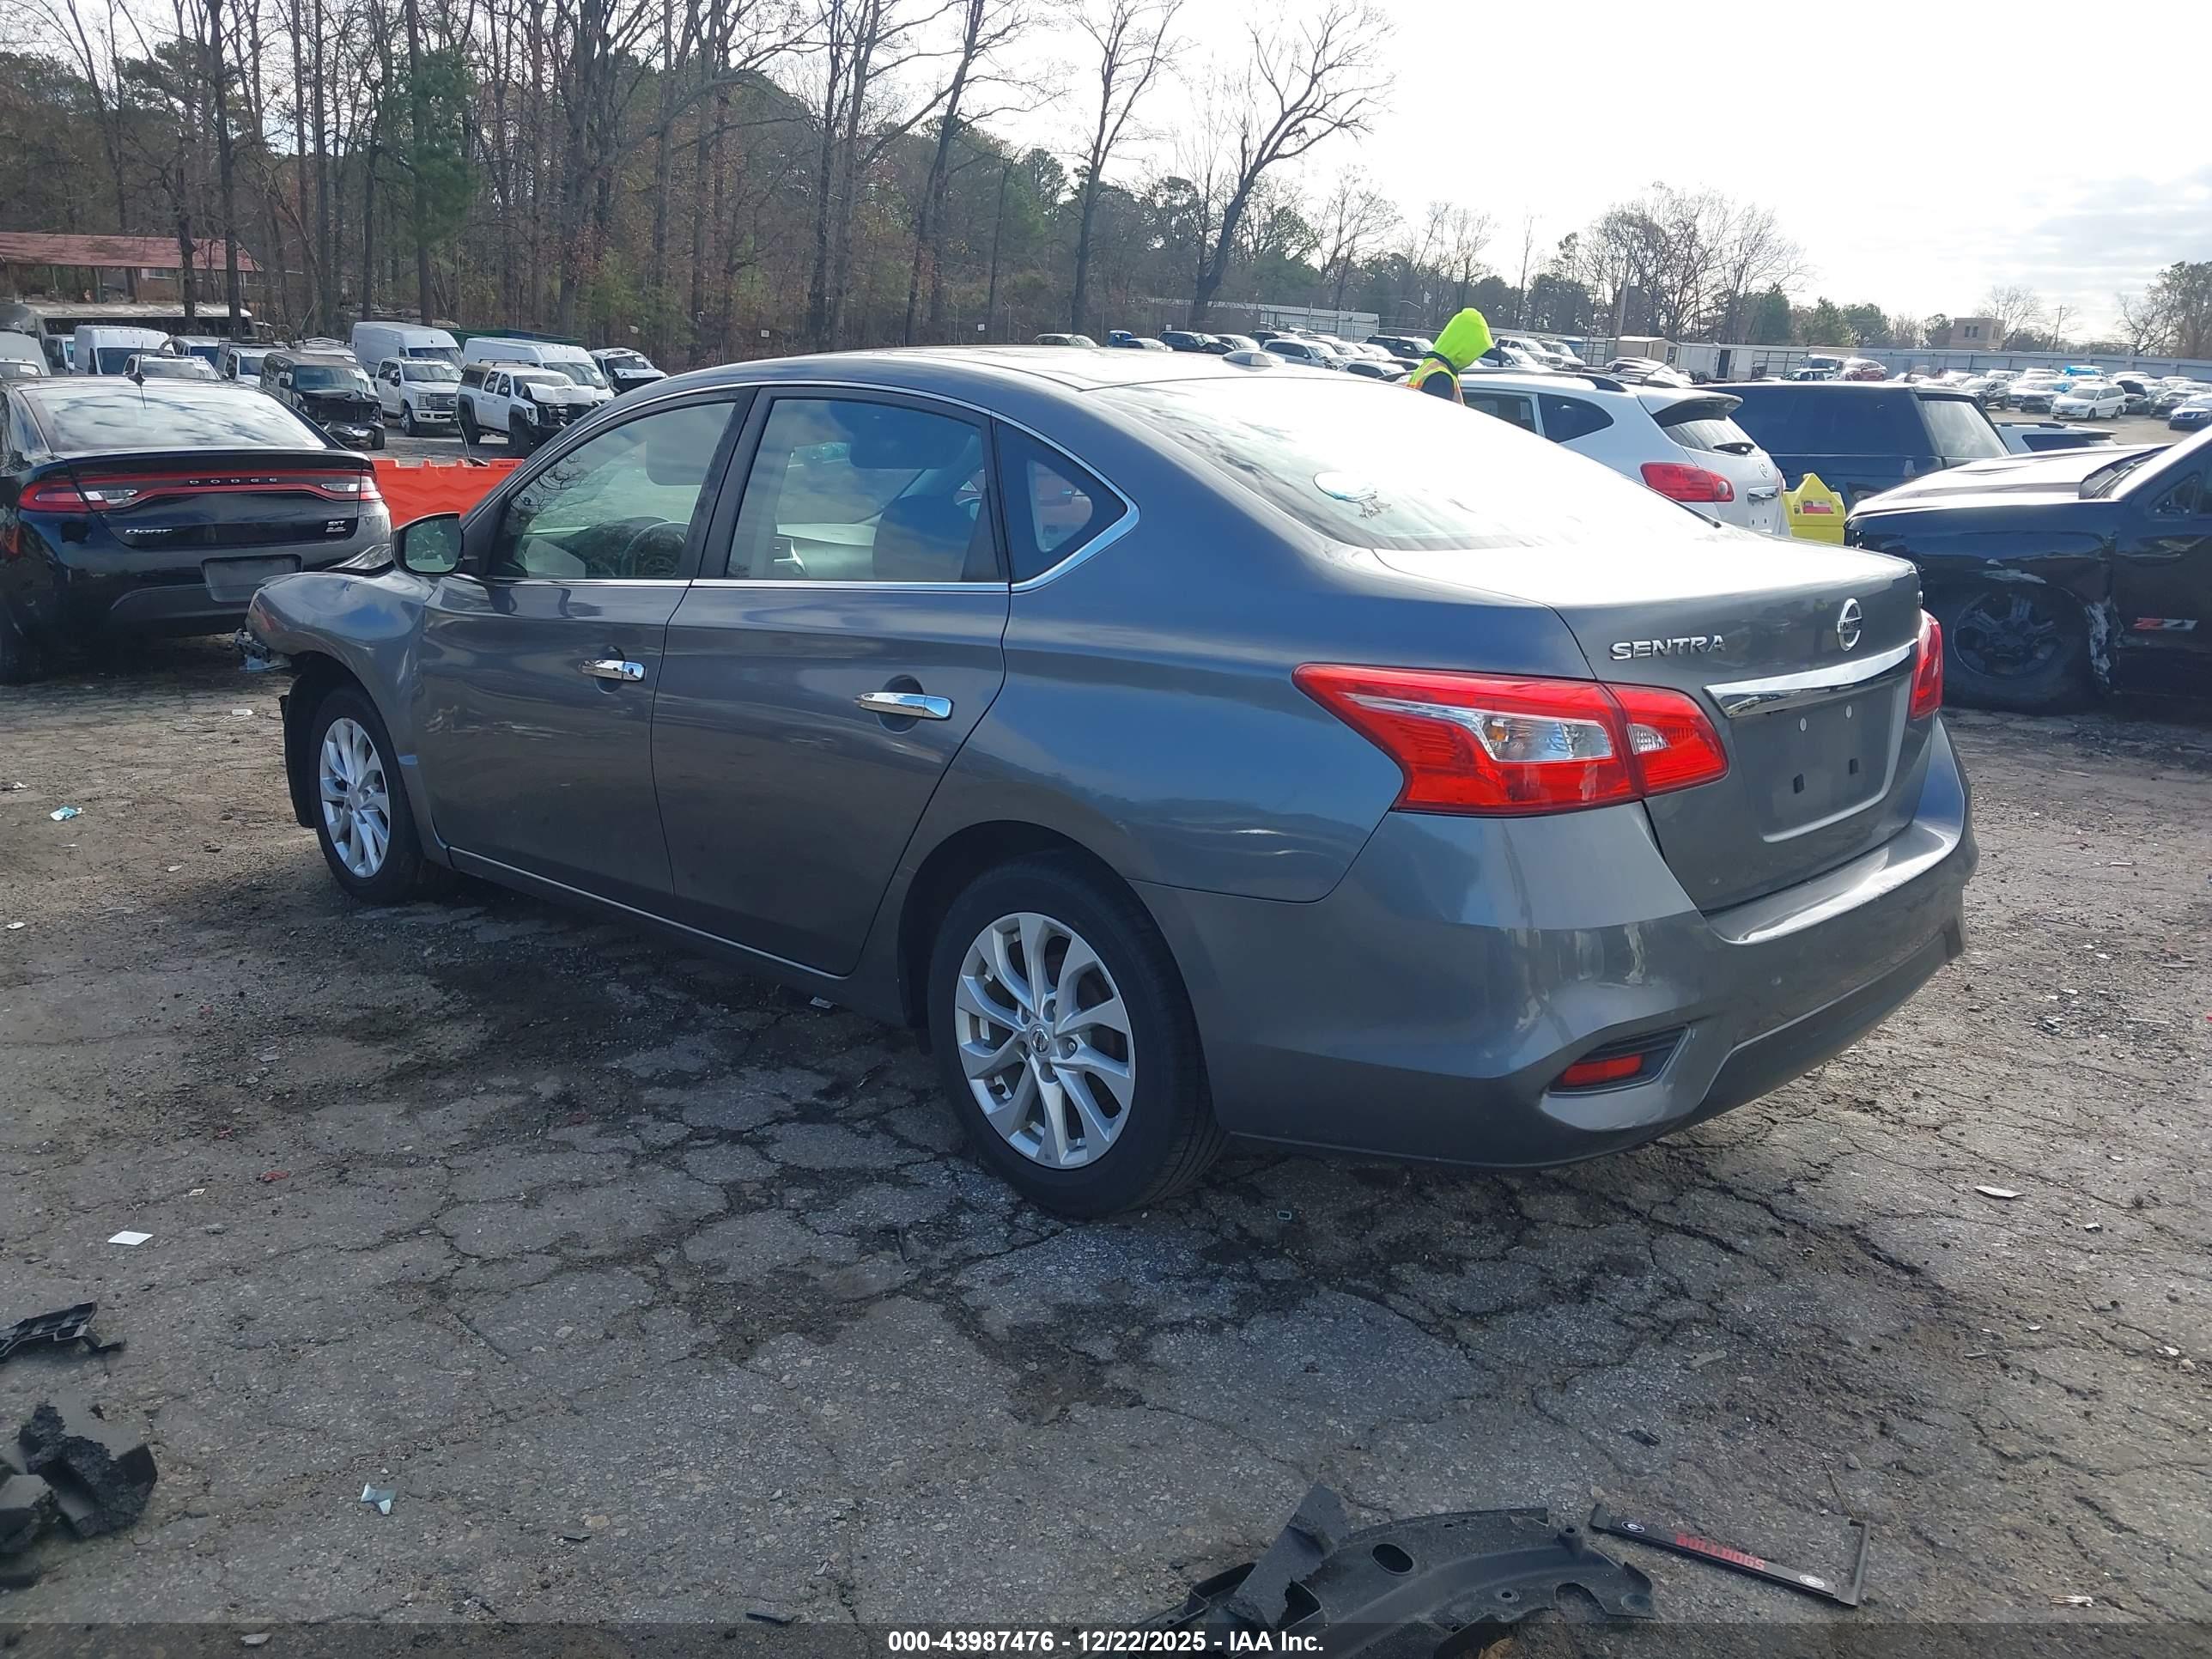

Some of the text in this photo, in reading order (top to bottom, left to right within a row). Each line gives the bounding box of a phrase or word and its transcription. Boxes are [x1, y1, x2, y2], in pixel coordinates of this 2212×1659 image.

[189, 477, 278, 485] DODGE
[2133, 617, 2199, 631] Z71
[1610, 635, 1726, 660] SENTRA
[1676, 1532, 1765, 1571] BULLDOGS
